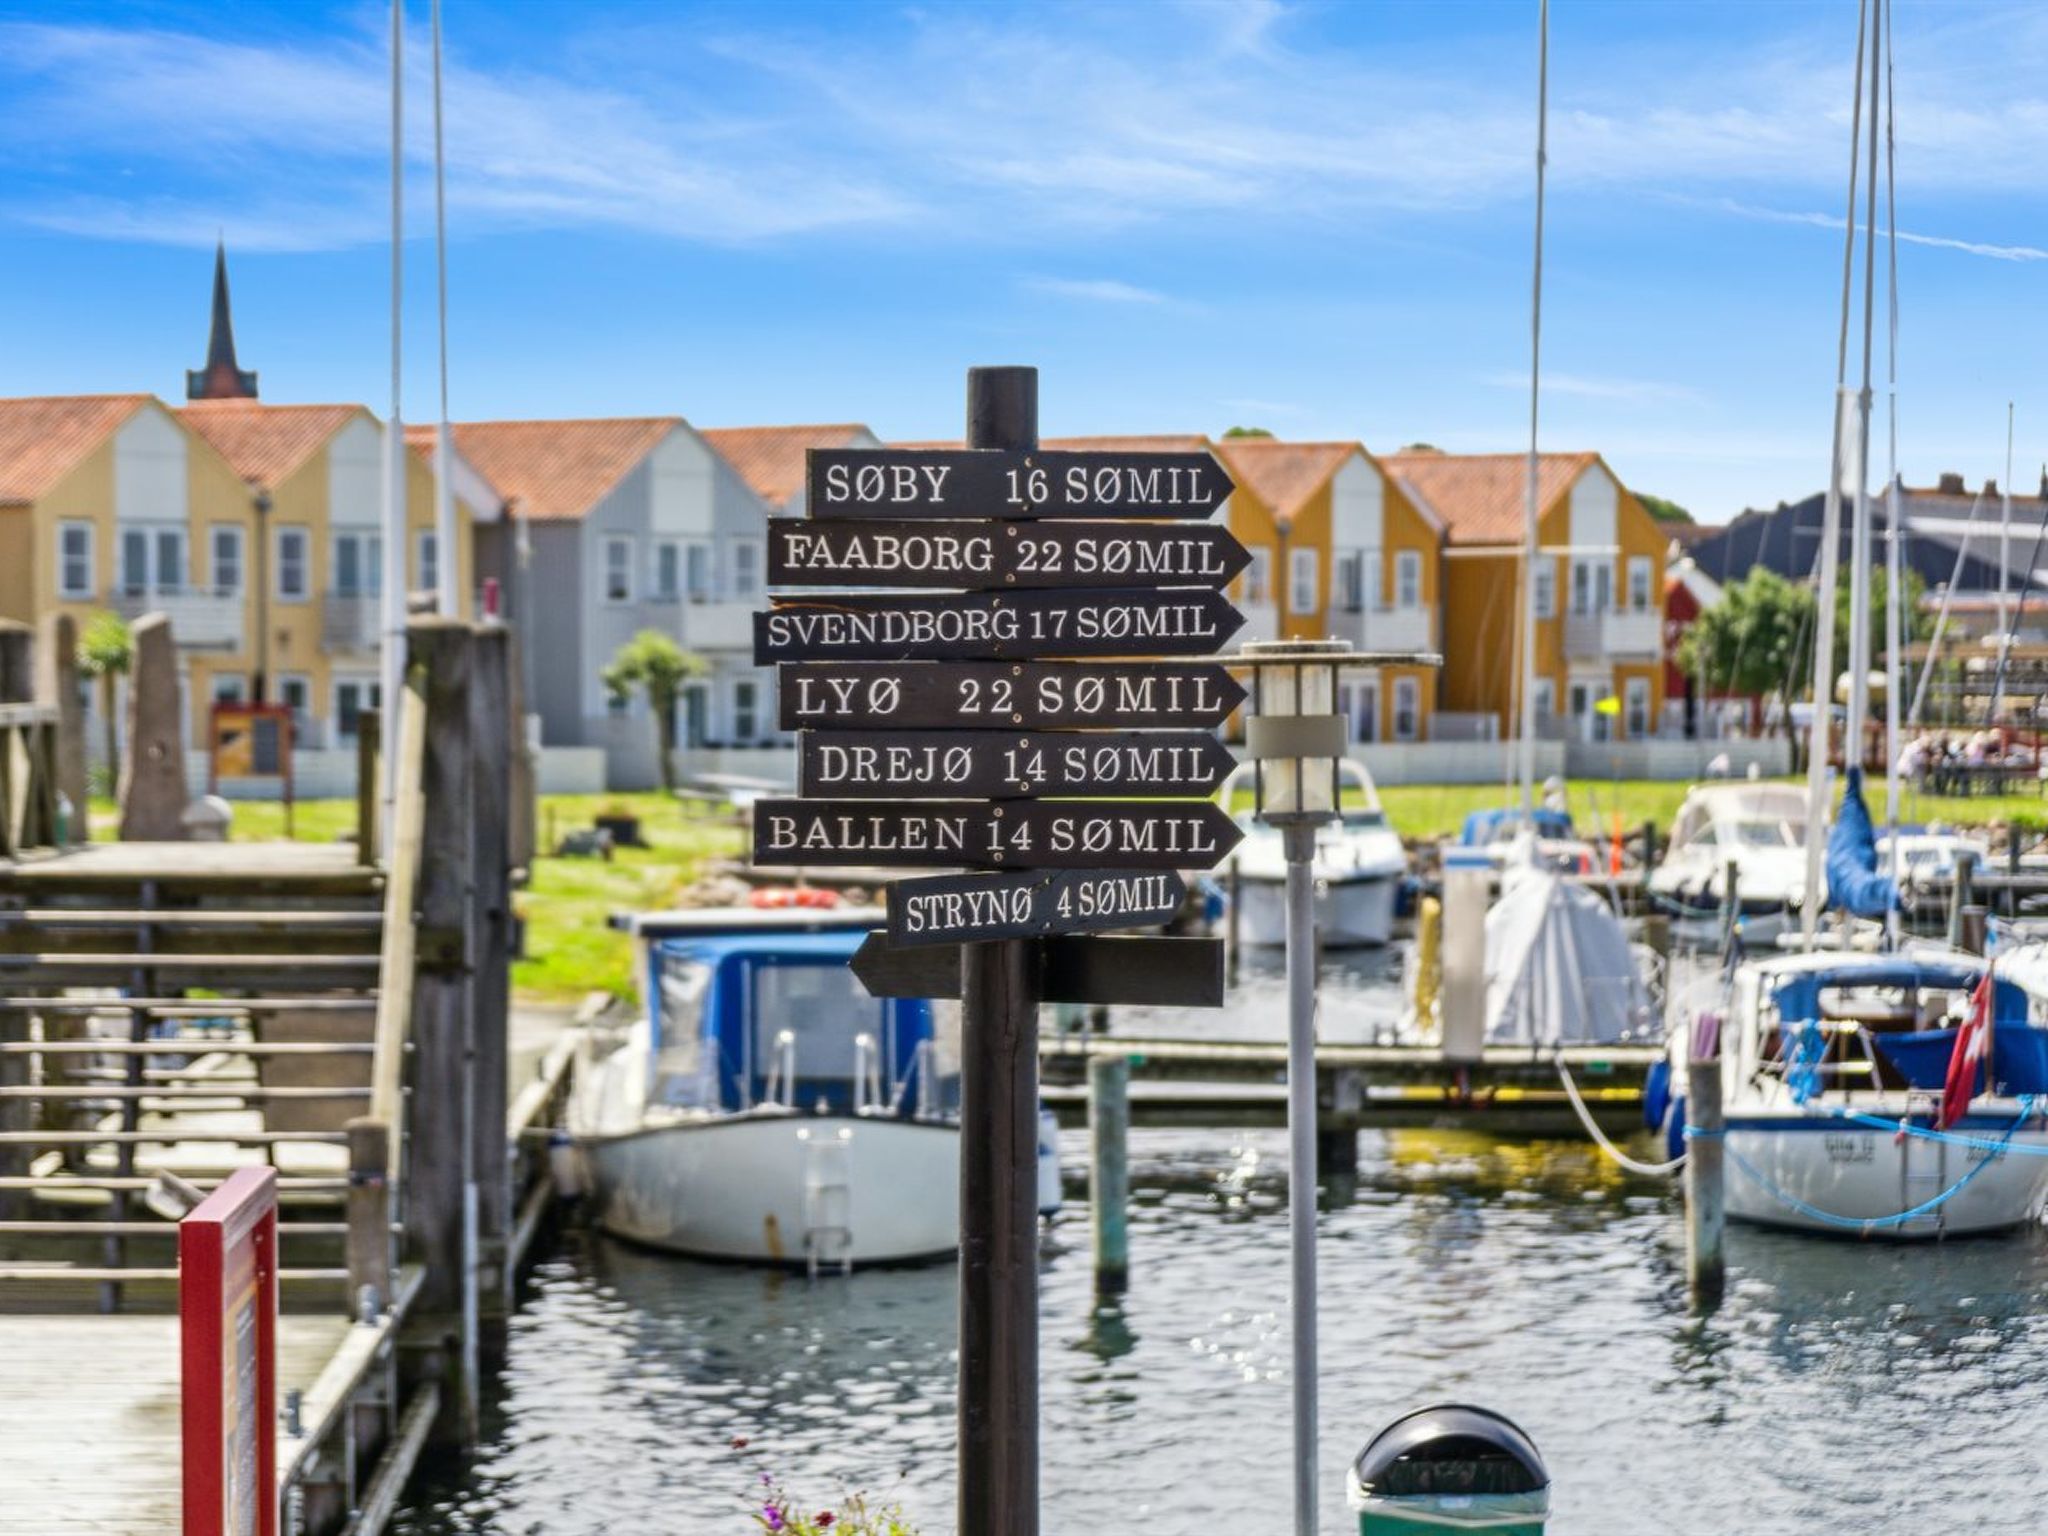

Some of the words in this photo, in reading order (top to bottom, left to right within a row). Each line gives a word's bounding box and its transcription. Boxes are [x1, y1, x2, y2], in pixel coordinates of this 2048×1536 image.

[827, 465, 951, 502] SØBY
[1007, 469, 1048, 503] 16
[1066, 467, 1211, 503] SØMIL
[784, 534, 994, 571] FAABORG
[1017, 540, 1061, 571] 22
[1074, 539, 1224, 574] SØMIL
[767, 610, 1019, 646] SVENDBORG
[1031, 610, 1067, 638] 17
[1077, 606, 1215, 637] SØMIL
[796, 678, 901, 714] LYØ
[959, 679, 1012, 713] 22
[1039, 677, 1221, 713] SØMIL
[819, 746, 972, 782] DREJØ
[1005, 750, 1046, 781] 14
[1065, 747, 1214, 782] SØMIL
[769, 817, 967, 849] BALLEN
[987, 821, 1032, 850] 14
[1051, 818, 1215, 852] SØMIL
[907, 887, 1032, 931] STRYNØ
[1056, 888, 1073, 918] 4
[1079, 875, 1174, 916] SØMIL
